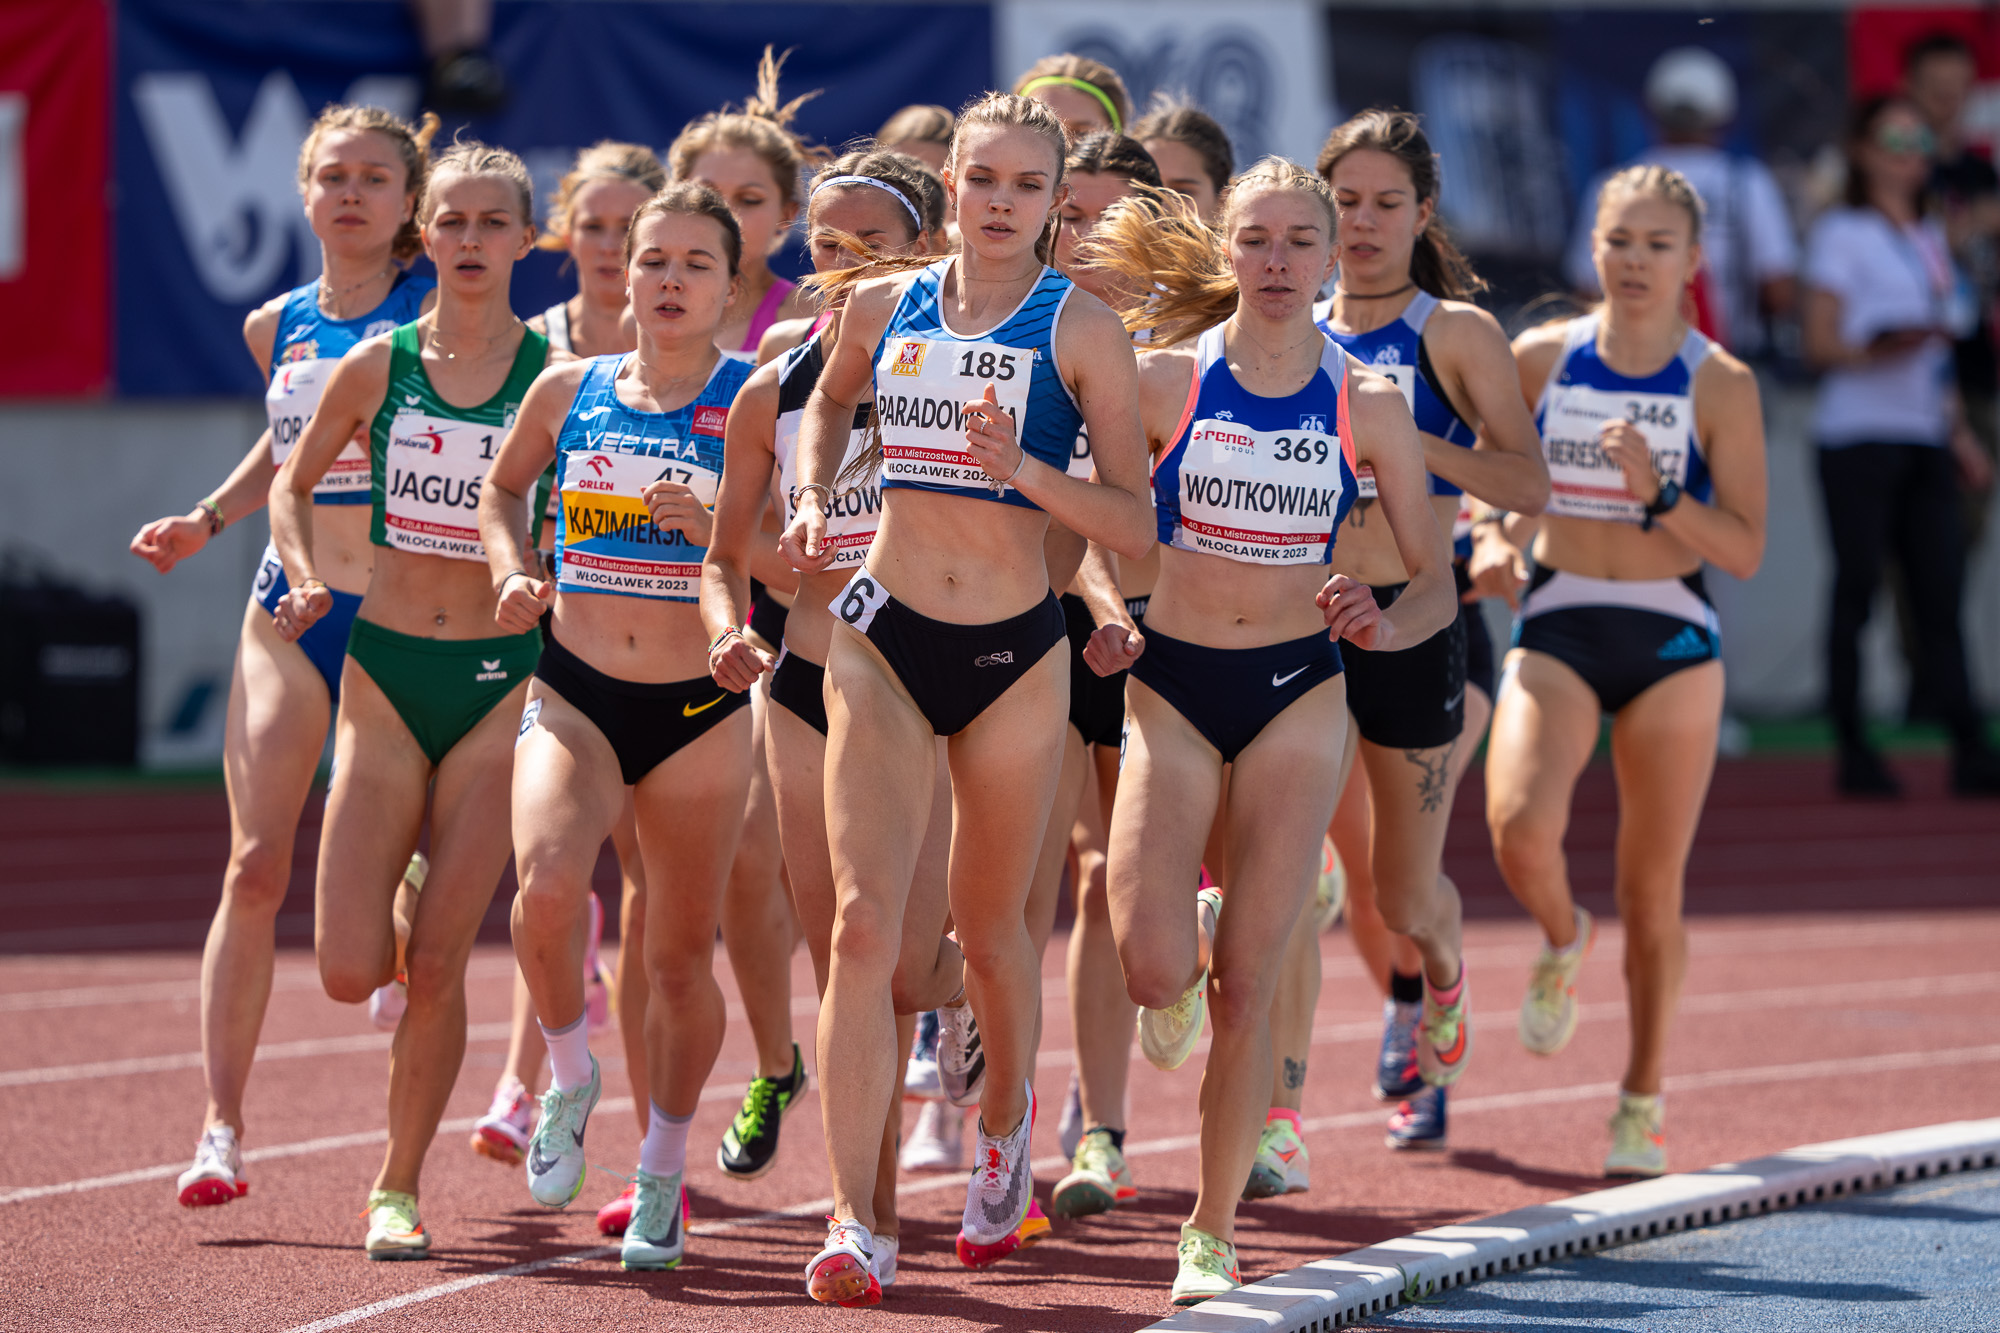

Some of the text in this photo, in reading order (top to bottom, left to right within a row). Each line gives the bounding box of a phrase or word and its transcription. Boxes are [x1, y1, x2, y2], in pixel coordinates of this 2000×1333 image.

[893, 364, 918, 375] PZLA
[959, 350, 1015, 380] 185
[880, 395, 1017, 437] PARADOW
[1626, 400, 1677, 428] 346
[273, 414, 313, 444] KOR
[1204, 430, 1256, 449] renex
[479, 435, 500, 460] 1
[888, 448, 903, 457] PZLA
[904, 449, 959, 463] Mistrzostwa
[1274, 437, 1328, 465] 369
[579, 479, 614, 491] ORLEN
[1185, 473, 1336, 517] WOJTKOWIAK
[401, 519, 422, 530] PZLA
[423, 523, 478, 539] Mistrzostwa
[1188, 520, 1321, 544] 40. PZLA Mistrzostwa Polski U23
[396, 532, 478, 554] WŁOCŁAWEK
[1196, 536, 1308, 559] WŁOCŁAWEK 2023
[569, 554, 700, 576] 40. PZLA Mistrzostwa Polski U23
[576, 570, 688, 591] WŁOCŁAWEK 2023
[840, 577, 875, 625] 6
[475, 671, 508, 681] erima
